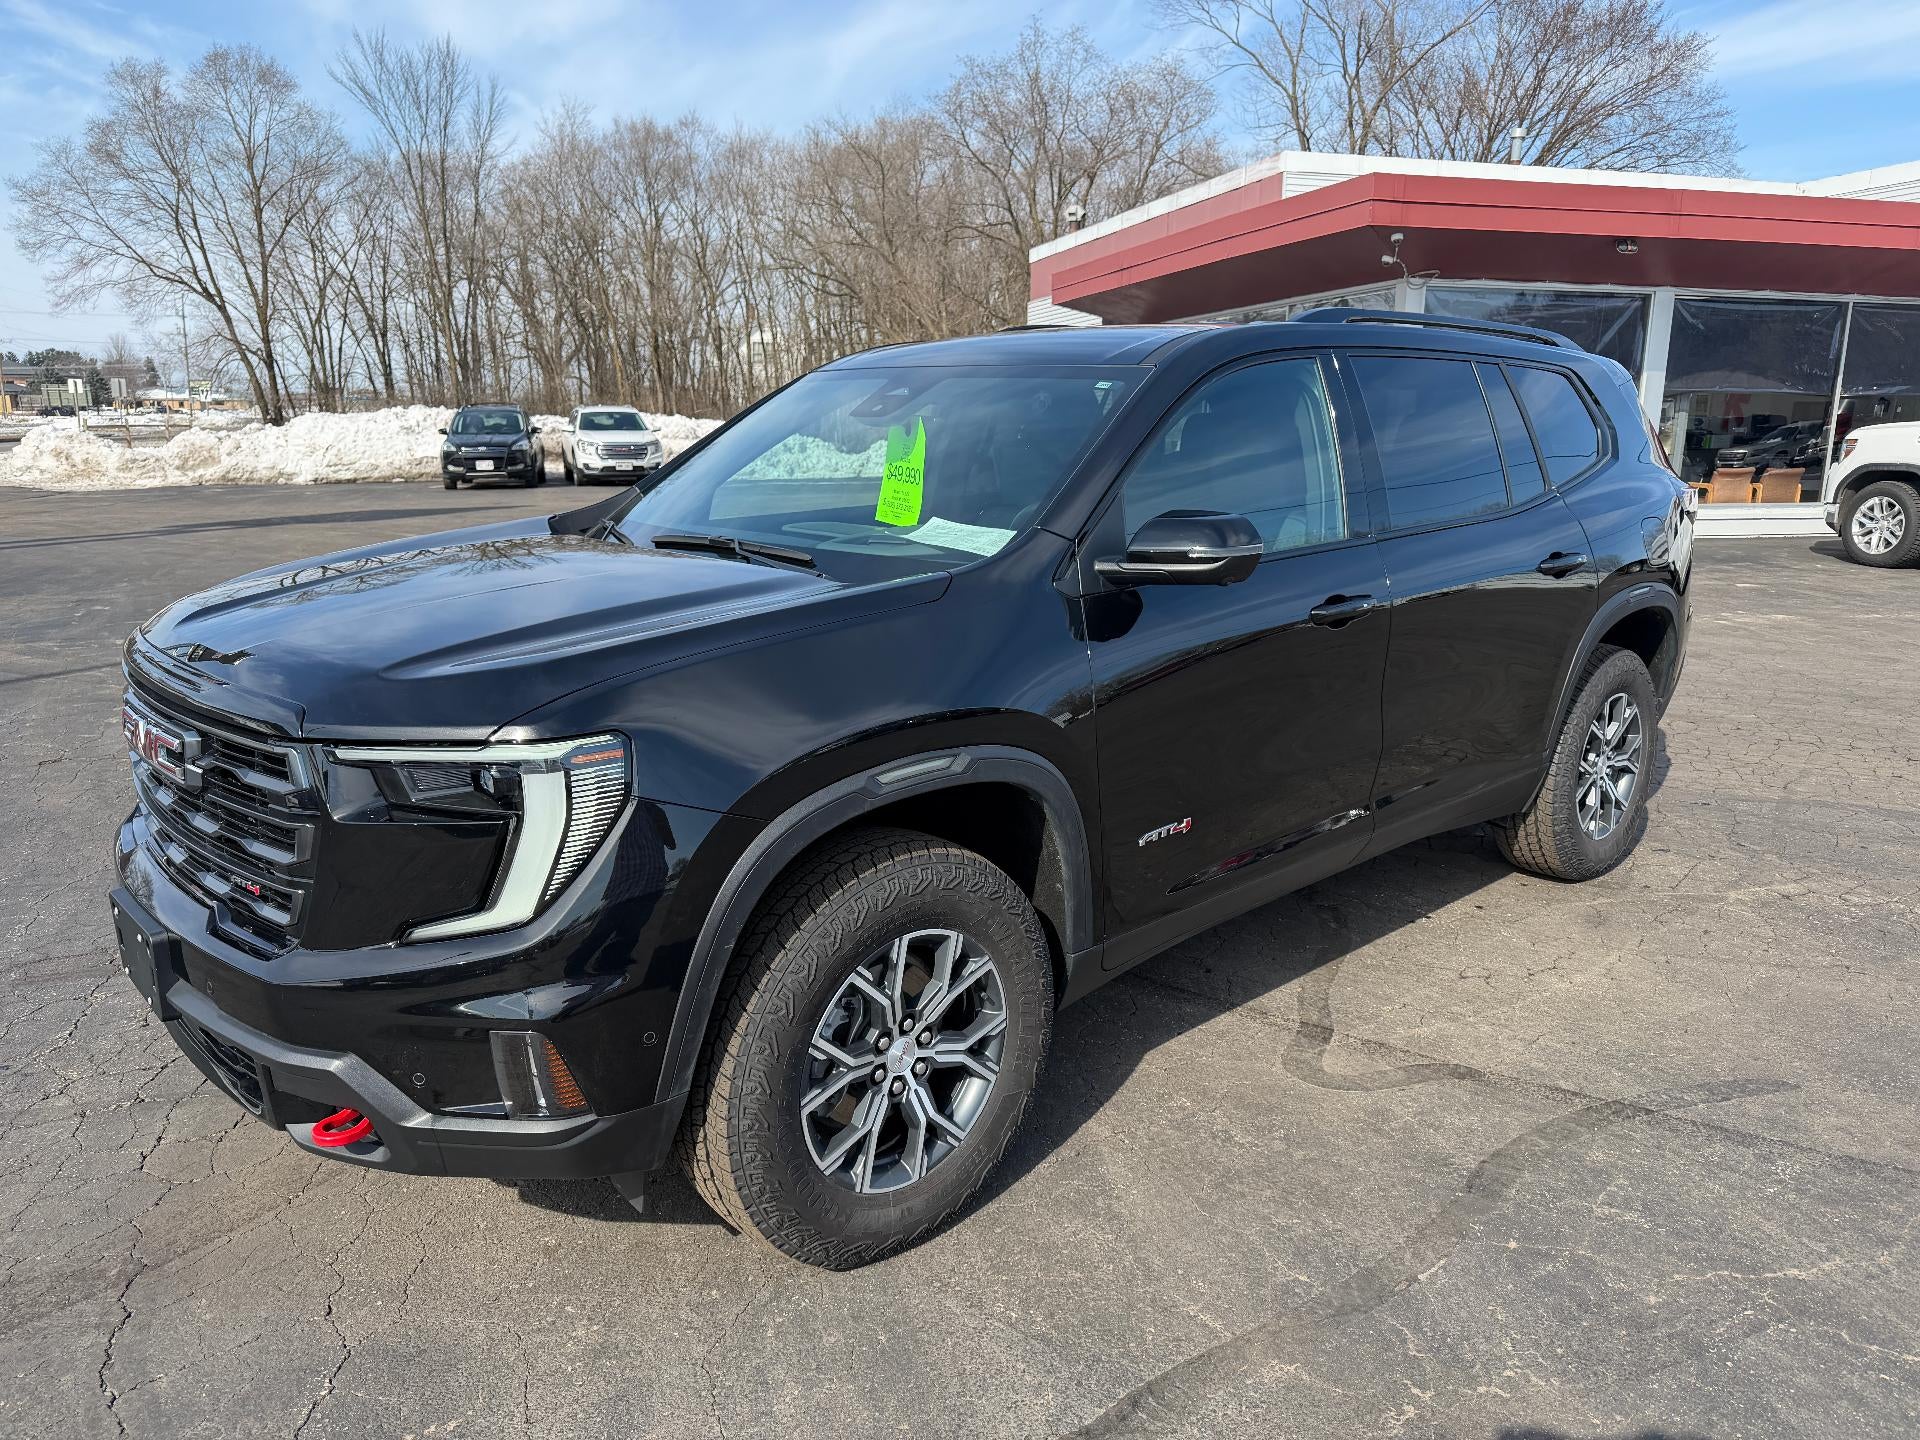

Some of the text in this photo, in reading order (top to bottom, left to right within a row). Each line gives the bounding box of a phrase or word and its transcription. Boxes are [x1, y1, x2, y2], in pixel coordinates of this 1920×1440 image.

[887, 463, 921, 486] $49,990
[121, 704, 184, 780] GMC
[1138, 817, 1192, 847] AT4
